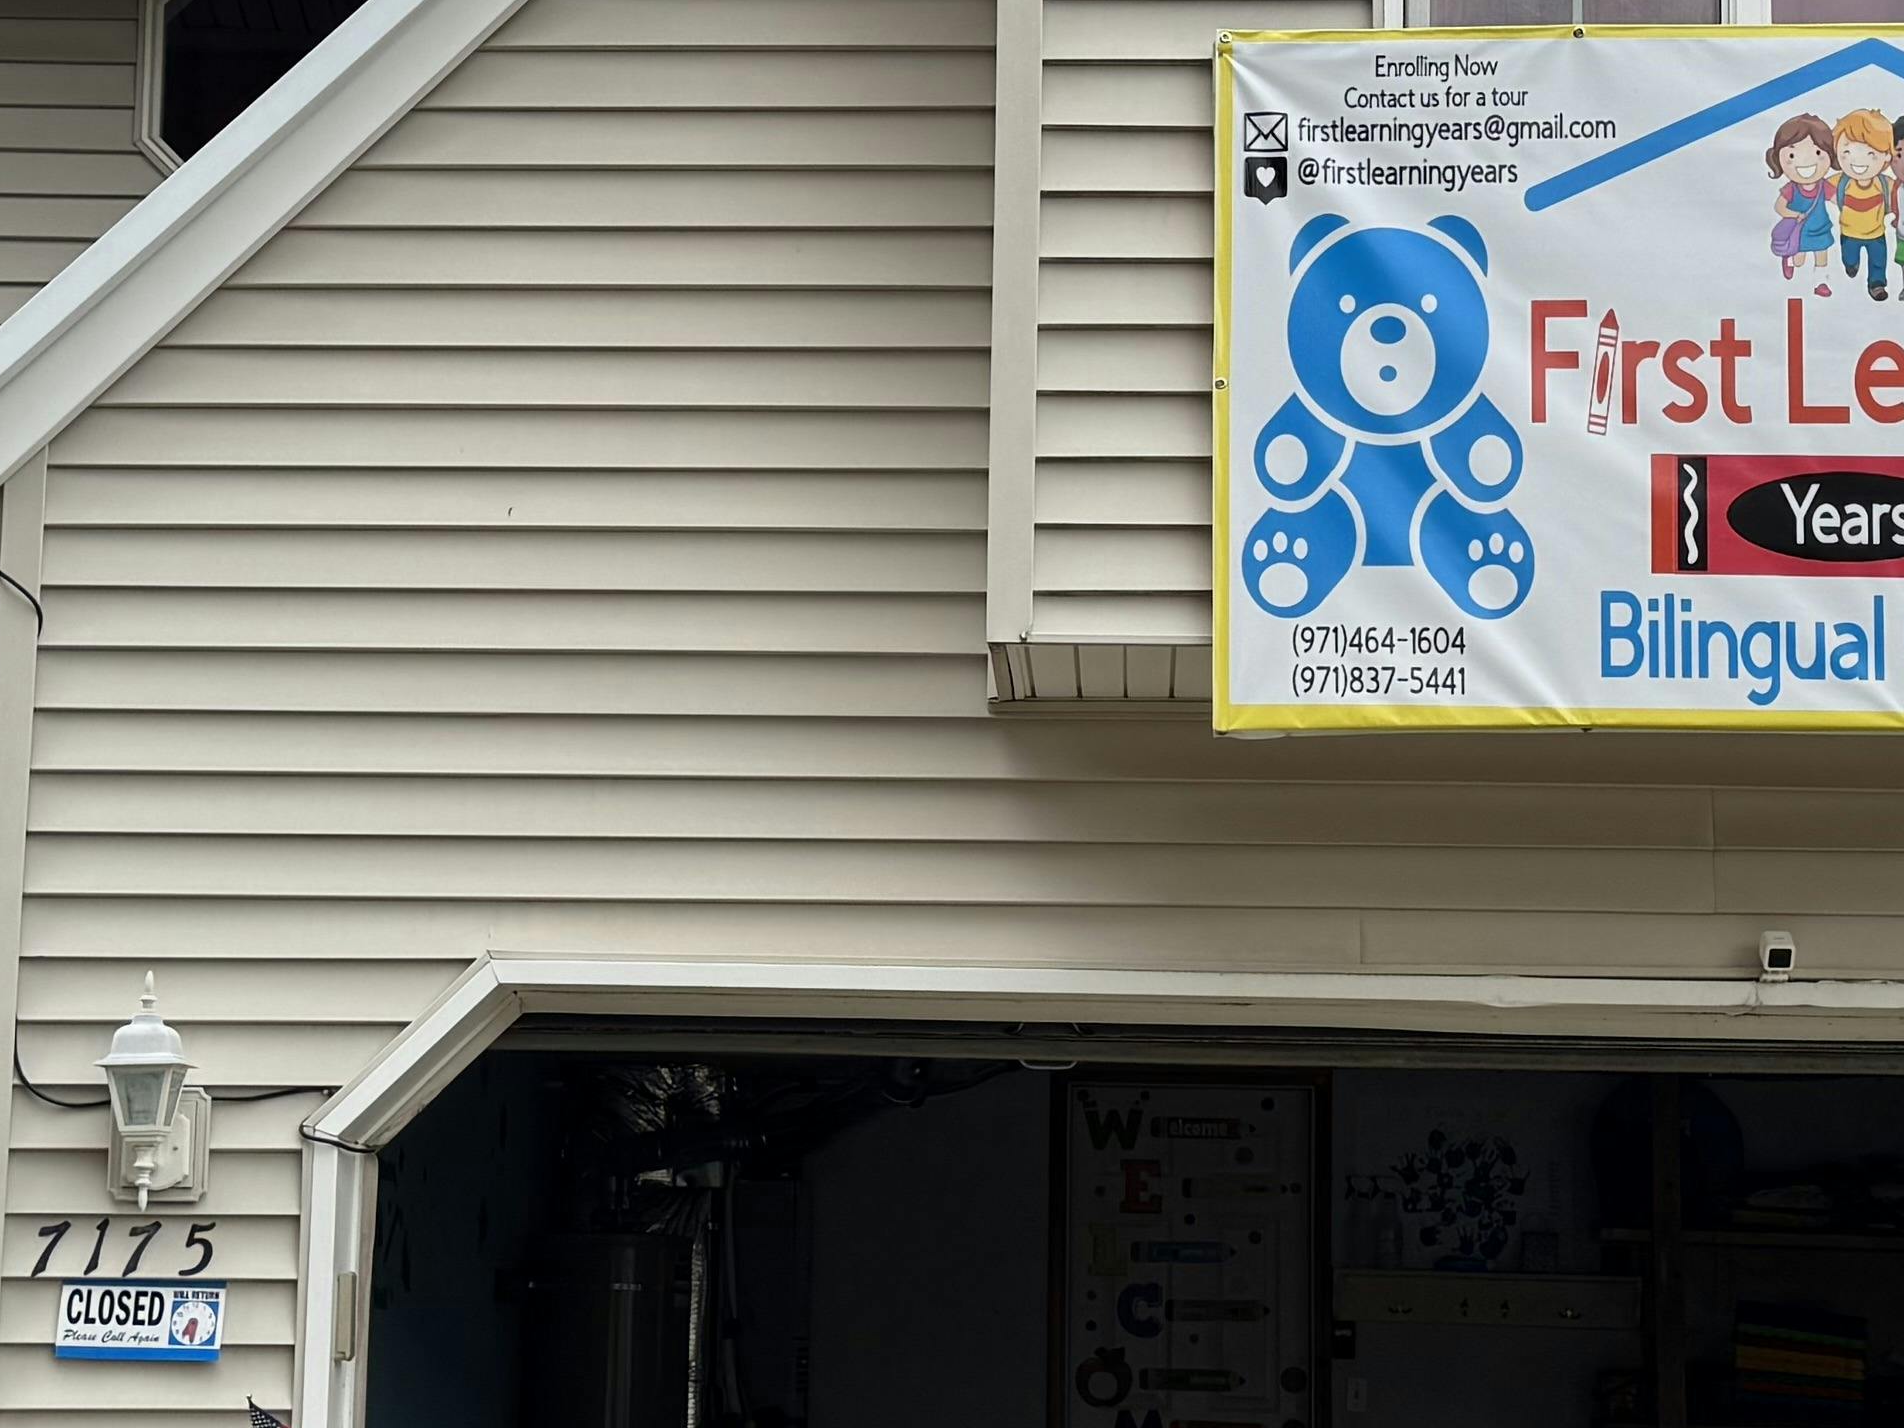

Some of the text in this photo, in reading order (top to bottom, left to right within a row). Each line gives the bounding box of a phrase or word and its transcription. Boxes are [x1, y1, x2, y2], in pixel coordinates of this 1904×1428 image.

[1375, 54, 1499, 83] Enrolling Now
[1343, 86, 1529, 109] Contact us for a tour
[1297, 112, 1617, 149] firstlearningyears@gmail.com
[1297, 157, 1519, 192] @firstlearningyears
[1529, 299, 1753, 436] First
[1292, 623, 1466, 658] (971)464-1604
[1600, 589, 1886, 706] Bilingual
[1292, 663, 1466, 697] (971)837-5441
[30, 1217, 217, 1278] 7175
[66, 1288, 165, 1327] CLOSED
[62, 1329, 160, 1345] Please Call Again
